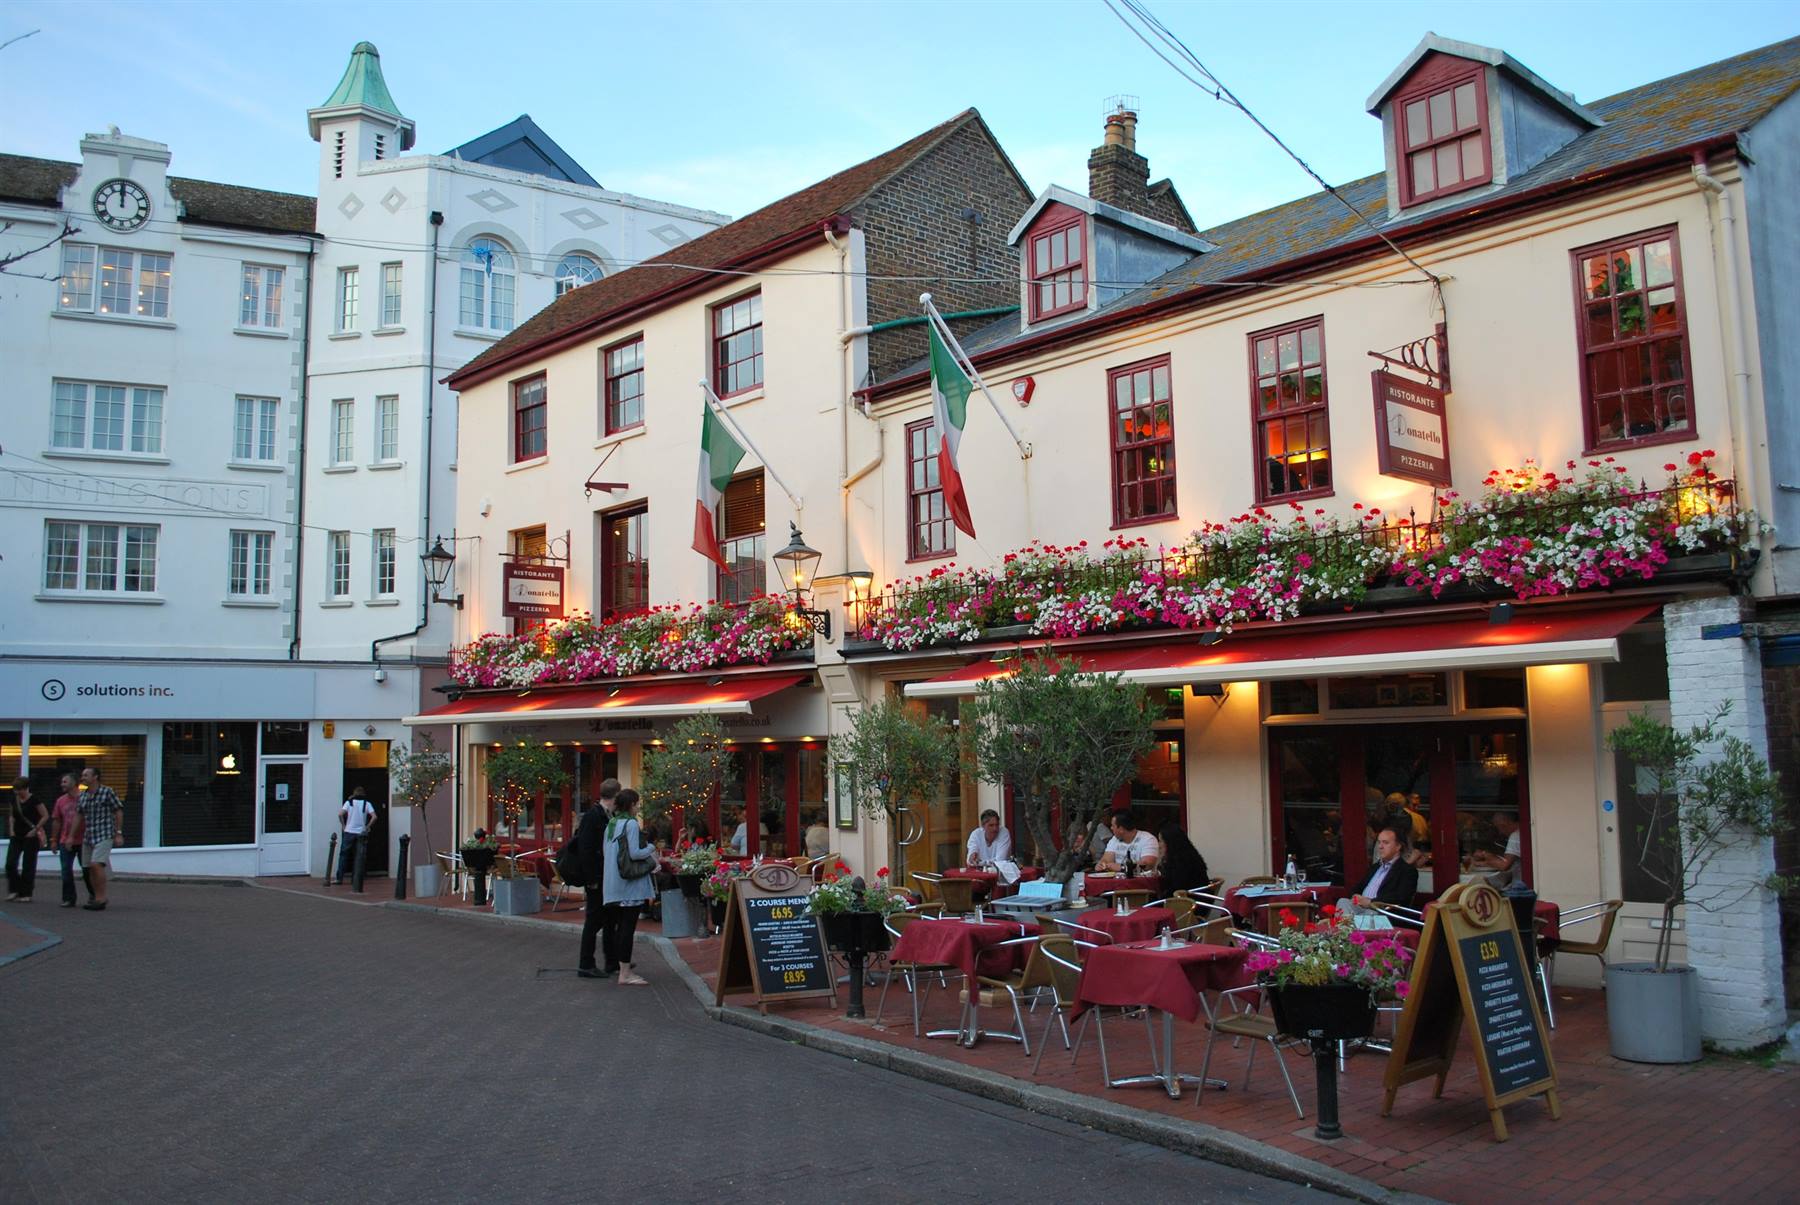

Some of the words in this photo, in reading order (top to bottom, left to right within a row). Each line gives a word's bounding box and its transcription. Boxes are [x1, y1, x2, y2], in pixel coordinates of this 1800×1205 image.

[1389, 388, 1435, 408] RISTORANTE
[1388, 414, 1441, 443] Donatello
[1401, 456, 1434, 471] PIZZERIA
[513, 570, 555, 578] RISTORANTE
[512, 583, 560, 599] Donatello
[519, 605, 551, 613] PIZZERIA
[77, 683, 145, 697] solutions
[149, 684, 175, 697] inc.
[750, 899, 756, 908] 2
[756, 898, 787, 907] COURSE
[771, 907, 793, 919] £6.95
[1480, 940, 1499, 961] £3.50
[770, 964, 780, 972] For
[781, 963, 786, 971] 3
[786, 962, 814, 970] COURSES
[784, 970, 806, 983] £8.95
